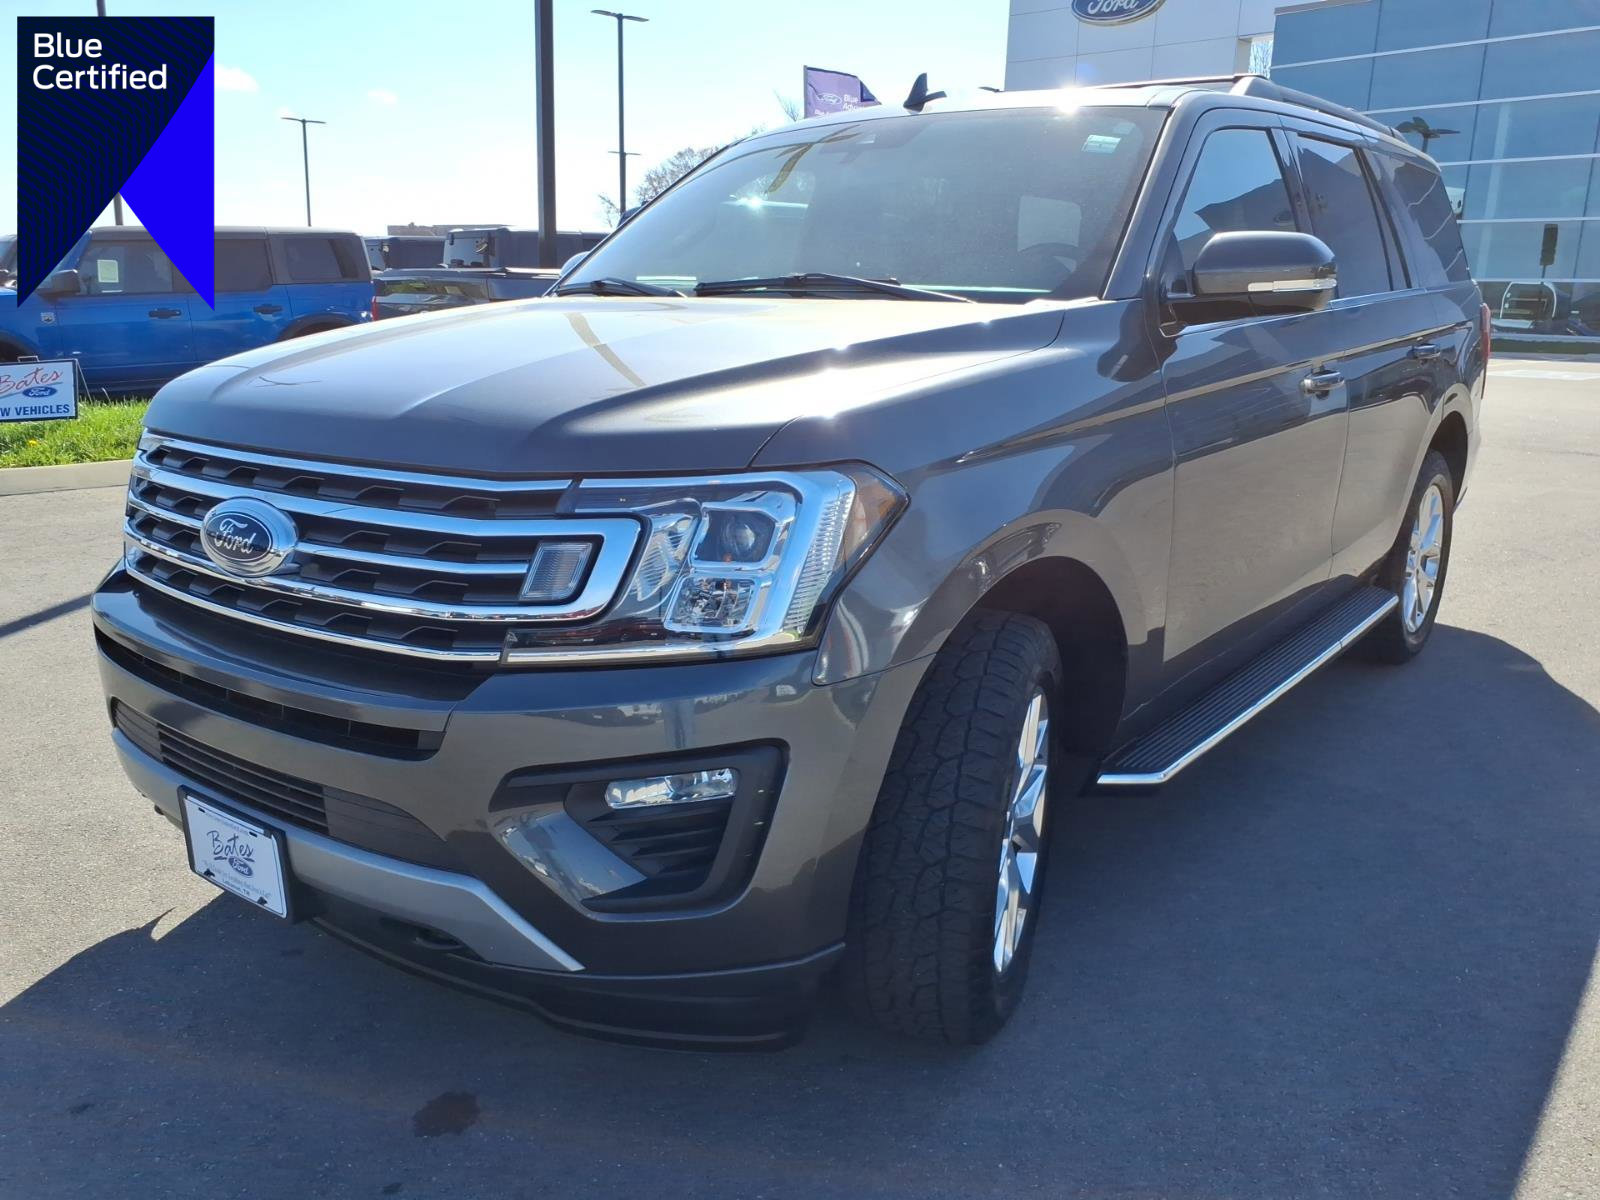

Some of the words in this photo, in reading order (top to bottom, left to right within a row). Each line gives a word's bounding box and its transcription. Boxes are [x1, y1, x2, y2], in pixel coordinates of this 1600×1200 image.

[0, 367, 63, 395] Bates
[15, 404, 70, 416] VEHICLES
[214, 518, 256, 555] Ford
[206, 830, 254, 858] Bates
[230, 859, 250, 875] Ford
